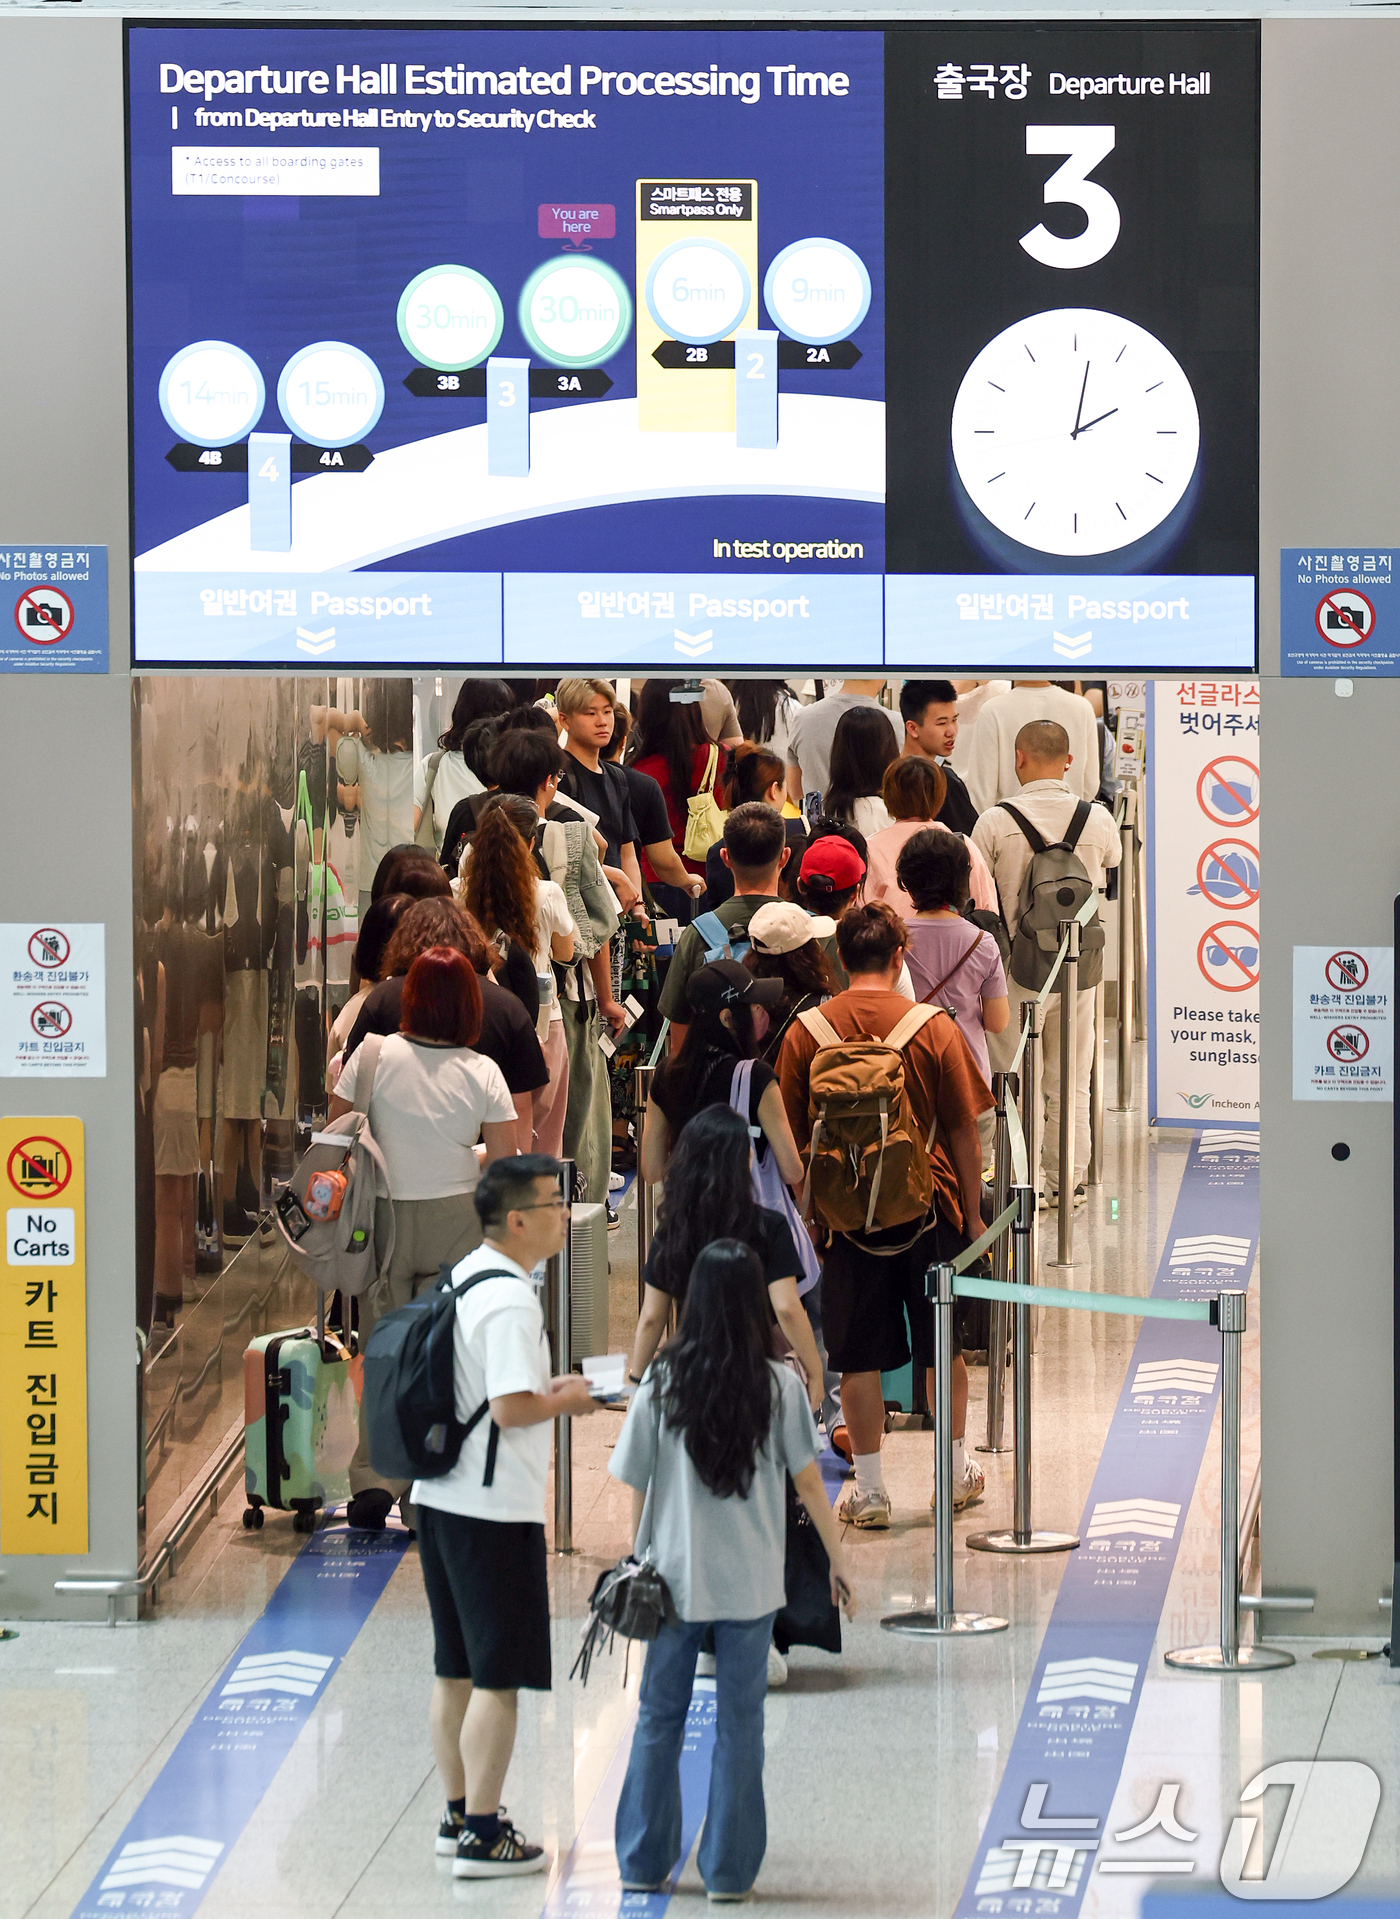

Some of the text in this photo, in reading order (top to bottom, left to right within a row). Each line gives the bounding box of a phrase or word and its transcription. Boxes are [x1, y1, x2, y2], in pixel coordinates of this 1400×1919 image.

[159, 63, 849, 104] Departure Hall Estimated Processing Time
[933, 64, 1032, 99] 출국장
[1049, 72, 1211, 100] Departure Hall
[193, 107, 596, 132] from Departure Hall Entry to Security Check
[194, 156, 364, 169] Access to all boarding gates
[185, 173, 280, 185] (T1/Concourse)
[651, 186, 742, 203] 스마트패스 전용
[1018, 124, 1121, 270] 3
[551, 208, 599, 221] You are
[650, 203, 743, 219] Smartpass Only
[562, 221, 591, 234] here
[672, 277, 726, 304] 6min
[791, 277, 846, 304] 9min
[415, 306, 488, 330] 30min
[538, 296, 616, 325] 30min
[685, 348, 709, 363] 2B
[806, 348, 831, 363] 2A
[746, 353, 765, 380] 2
[436, 376, 460, 392] 3B
[557, 376, 582, 392] 3A
[180, 381, 249, 406] 14min
[299, 381, 368, 406] 15min
[498, 380, 517, 408] 3
[198, 450, 222, 466] 4B
[320, 450, 345, 466] 4A
[259, 456, 279, 483] 4
[714, 540, 863, 563] In test operation
[0, 552, 90, 569] 사진촬영금지
[1298, 555, 1392, 571] 사진촬영금지
[14, 571, 48, 581] Photos
[50, 571, 89, 581] allowed
[1298, 574, 1392, 584] No Photos allowed
[200, 589, 432, 619] 일반여권 Passport
[578, 591, 810, 620] 일반여권 Passport
[956, 593, 1190, 623] 일반여권 Passport
[1176, 682, 1259, 707] 선글라스
[13, 971, 89, 982] 환송객 진입불가
[1309, 994, 1387, 1006] 환송객 진입불가
[1173, 1006, 1260, 1023] Please take
[1170, 1029, 1256, 1045] your mask,
[18, 1042, 85, 1052] 카트 진입금지
[1190, 1049, 1260, 1066] sunglass
[1314, 1065, 1381, 1077] 카트 진입금지
[1212, 1099, 1251, 1109] Incheon
[27, 1215, 57, 1233] No
[13, 1238, 70, 1257] Carts
[25, 1280, 59, 1526] 카트 진입금지
